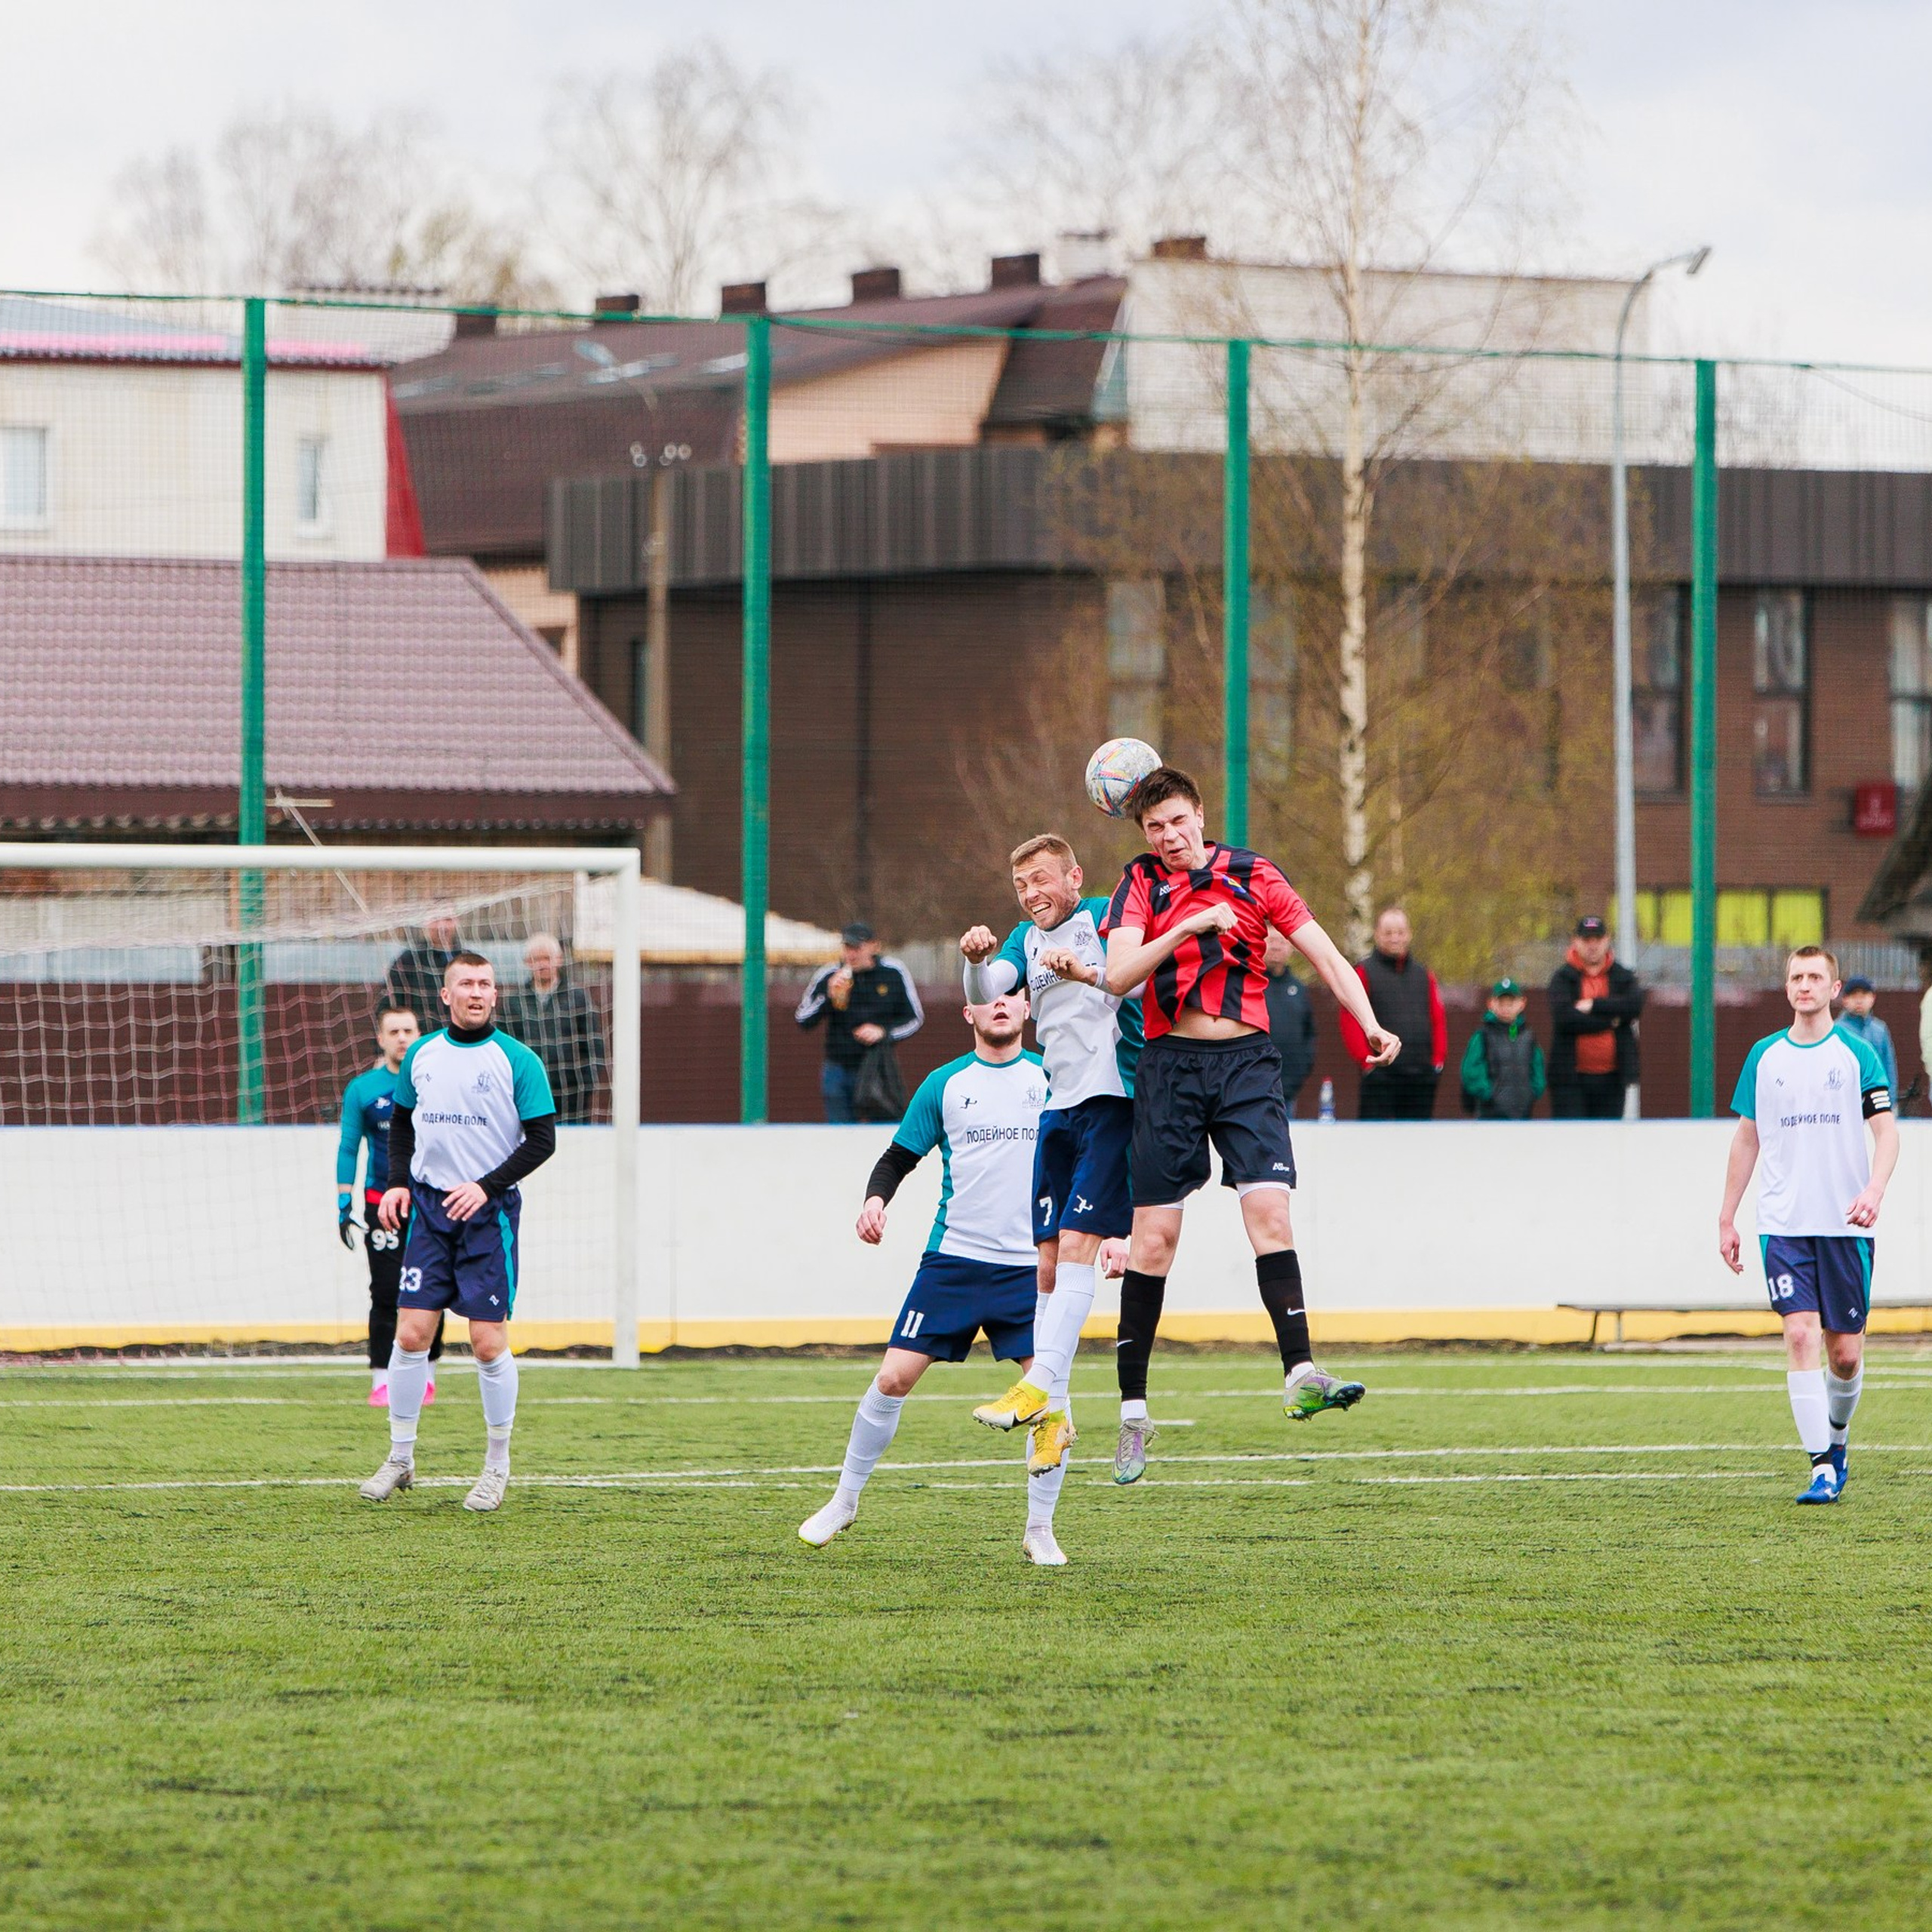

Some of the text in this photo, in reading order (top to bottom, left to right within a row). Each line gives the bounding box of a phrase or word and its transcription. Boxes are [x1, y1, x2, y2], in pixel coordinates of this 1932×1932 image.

[464, 1115, 488, 1126] ПОЛЕ
[1820, 1113, 1841, 1124] ПОЛЕ
[967, 1125, 1019, 1143] ЛОДЕЙНОЕ
[1038, 1196, 1053, 1226] 7
[371, 1229, 399, 1251] 95
[1768, 1273, 1795, 1301] 18
[900, 1310, 924, 1339] 11
